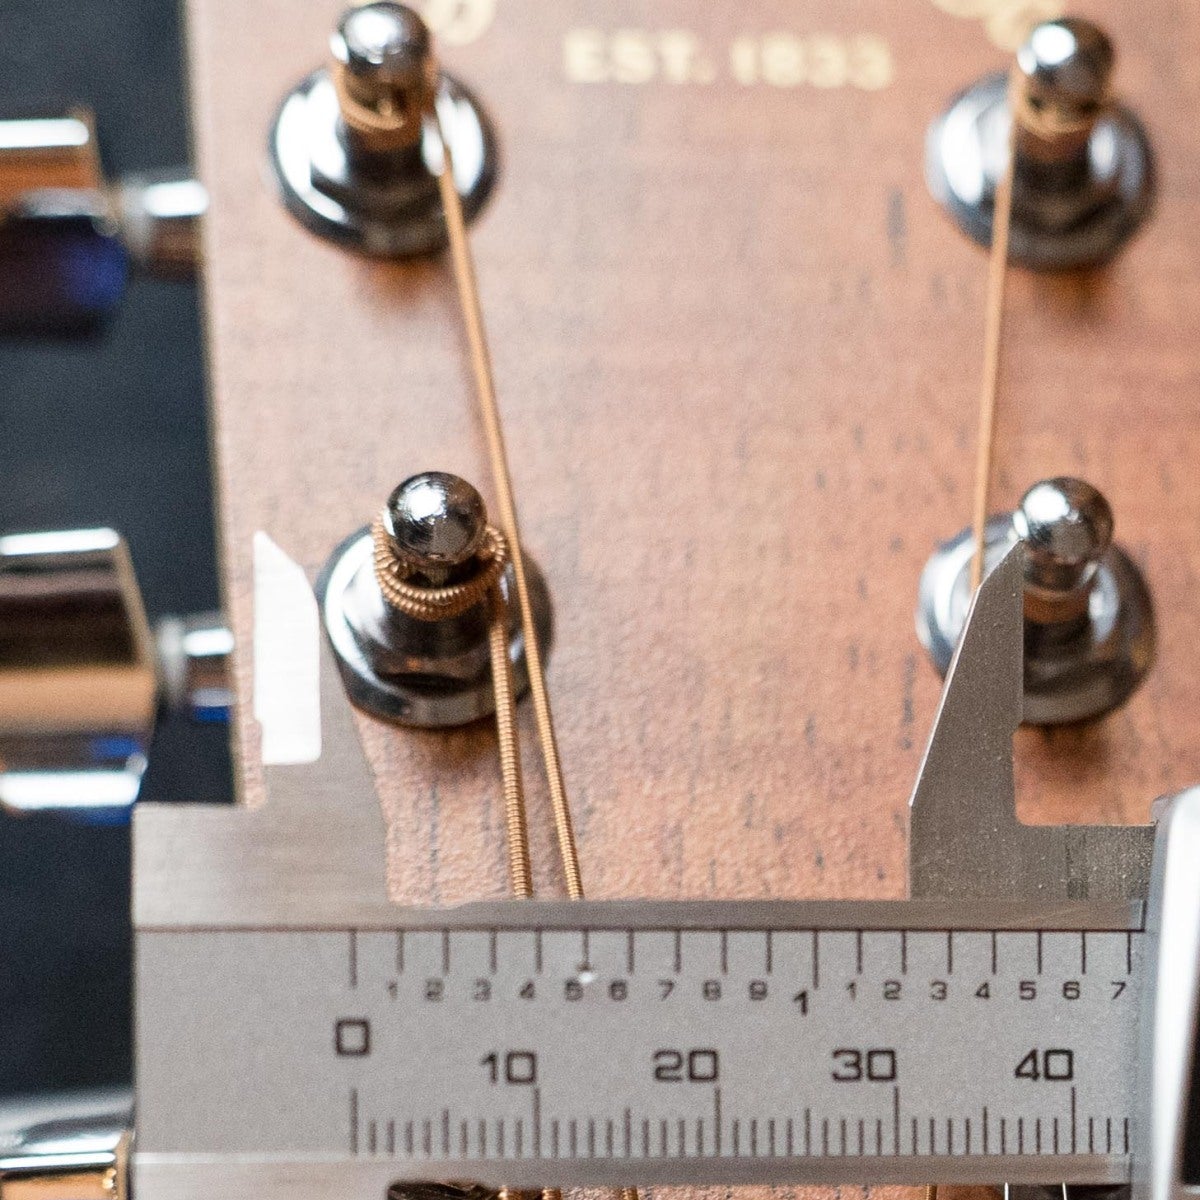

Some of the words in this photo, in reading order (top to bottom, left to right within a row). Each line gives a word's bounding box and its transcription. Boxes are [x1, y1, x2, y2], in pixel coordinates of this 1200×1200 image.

[562, 29, 716, 84] EST.
[387, 980, 399, 1000] 1
[424, 978, 444, 1001] 2
[474, 979, 492, 1001] 3
[519, 980, 536, 1000] 4
[564, 979, 584, 1001] 5
[609, 979, 628, 1001] 6
[658, 980, 675, 1000] 7
[702, 980, 722, 1001] 8
[749, 980, 768, 1000] 9
[793, 990, 808, 1016] 1
[845, 981, 857, 1001] 1
[883, 981, 901, 1000] 2
[931, 981, 949, 1001] 3
[975, 981, 991, 1000] 4
[1019, 981, 1037, 1001] 5
[1062, 981, 1081, 1001] 6
[1110, 981, 1127, 1001] 7
[335, 1018, 371, 1057] 0
[480, 1051, 537, 1085] 10
[653, 1049, 719, 1082] 20
[832, 1048, 897, 1082] 30
[1014, 1048, 1075, 1082] 40
